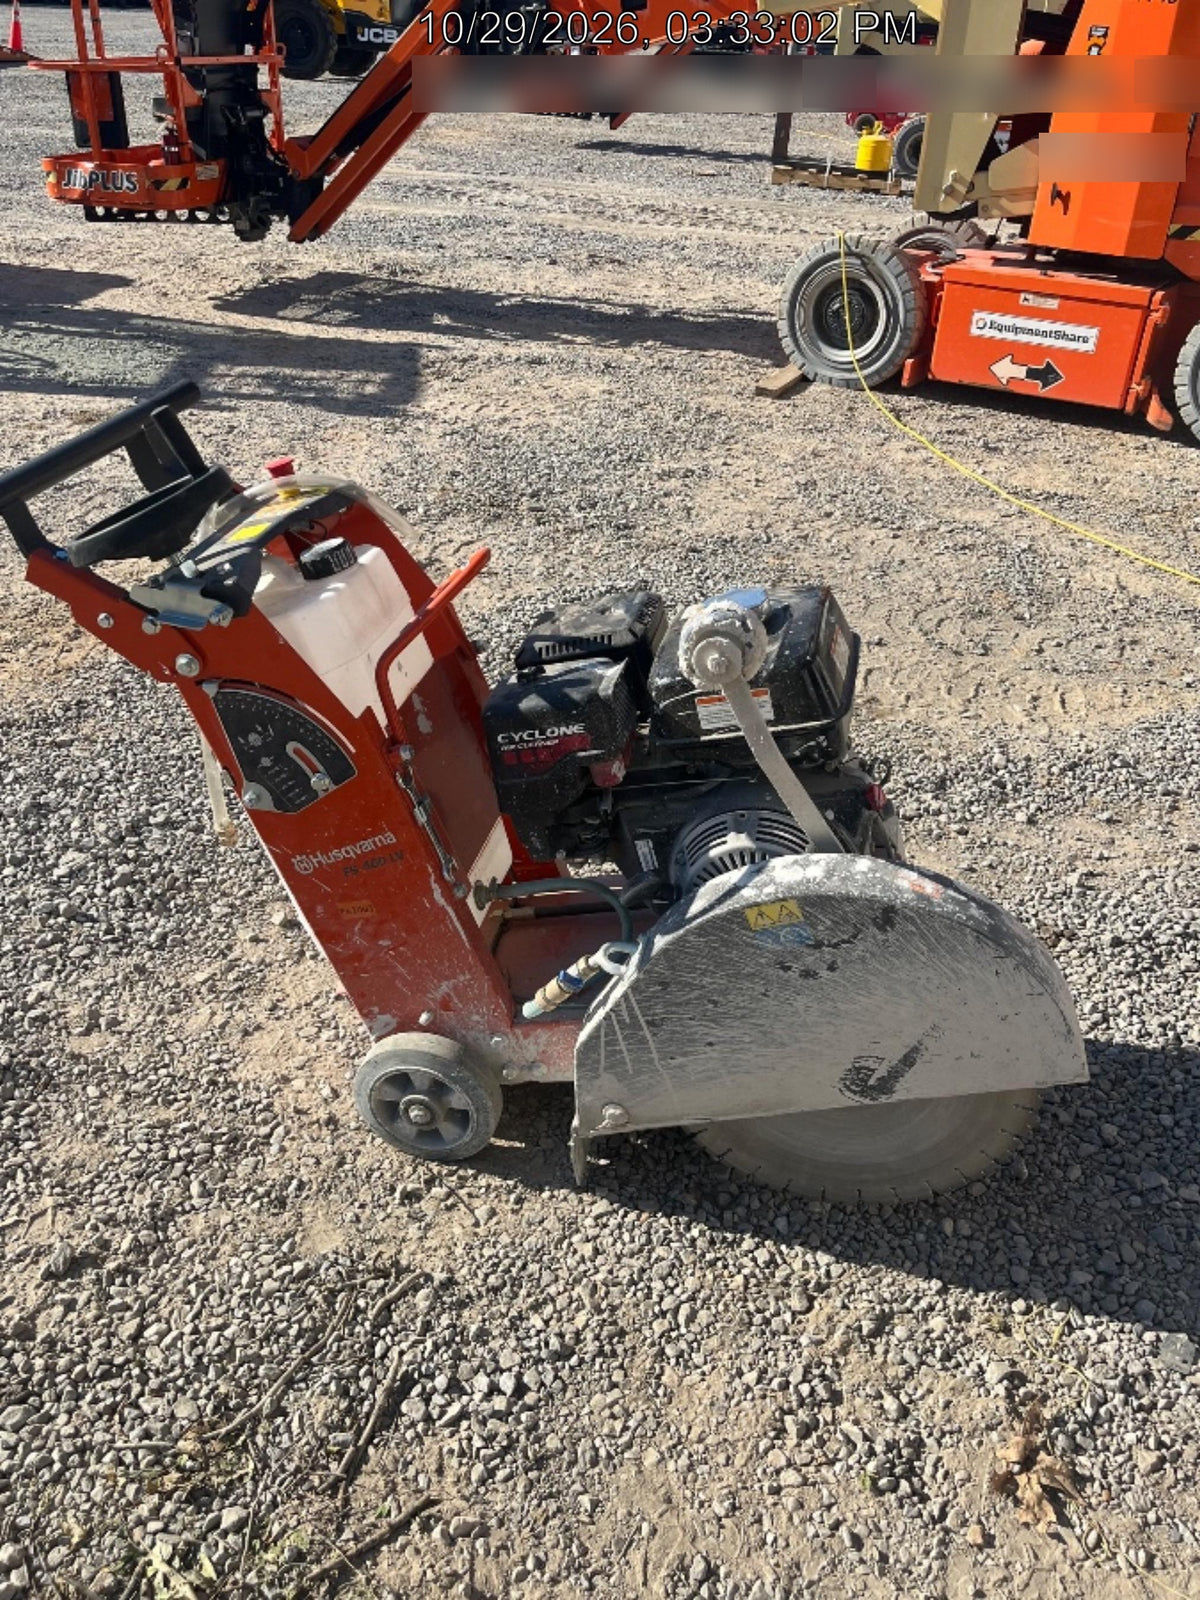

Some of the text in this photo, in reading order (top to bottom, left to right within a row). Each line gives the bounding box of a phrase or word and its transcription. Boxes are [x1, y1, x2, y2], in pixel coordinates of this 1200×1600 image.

[356, 27, 398, 44] JCB
[988, 319, 1090, 344] EquipmentShare
[497, 723, 586, 744] CYCLONE
[309, 831, 397, 869] Husqvarna
